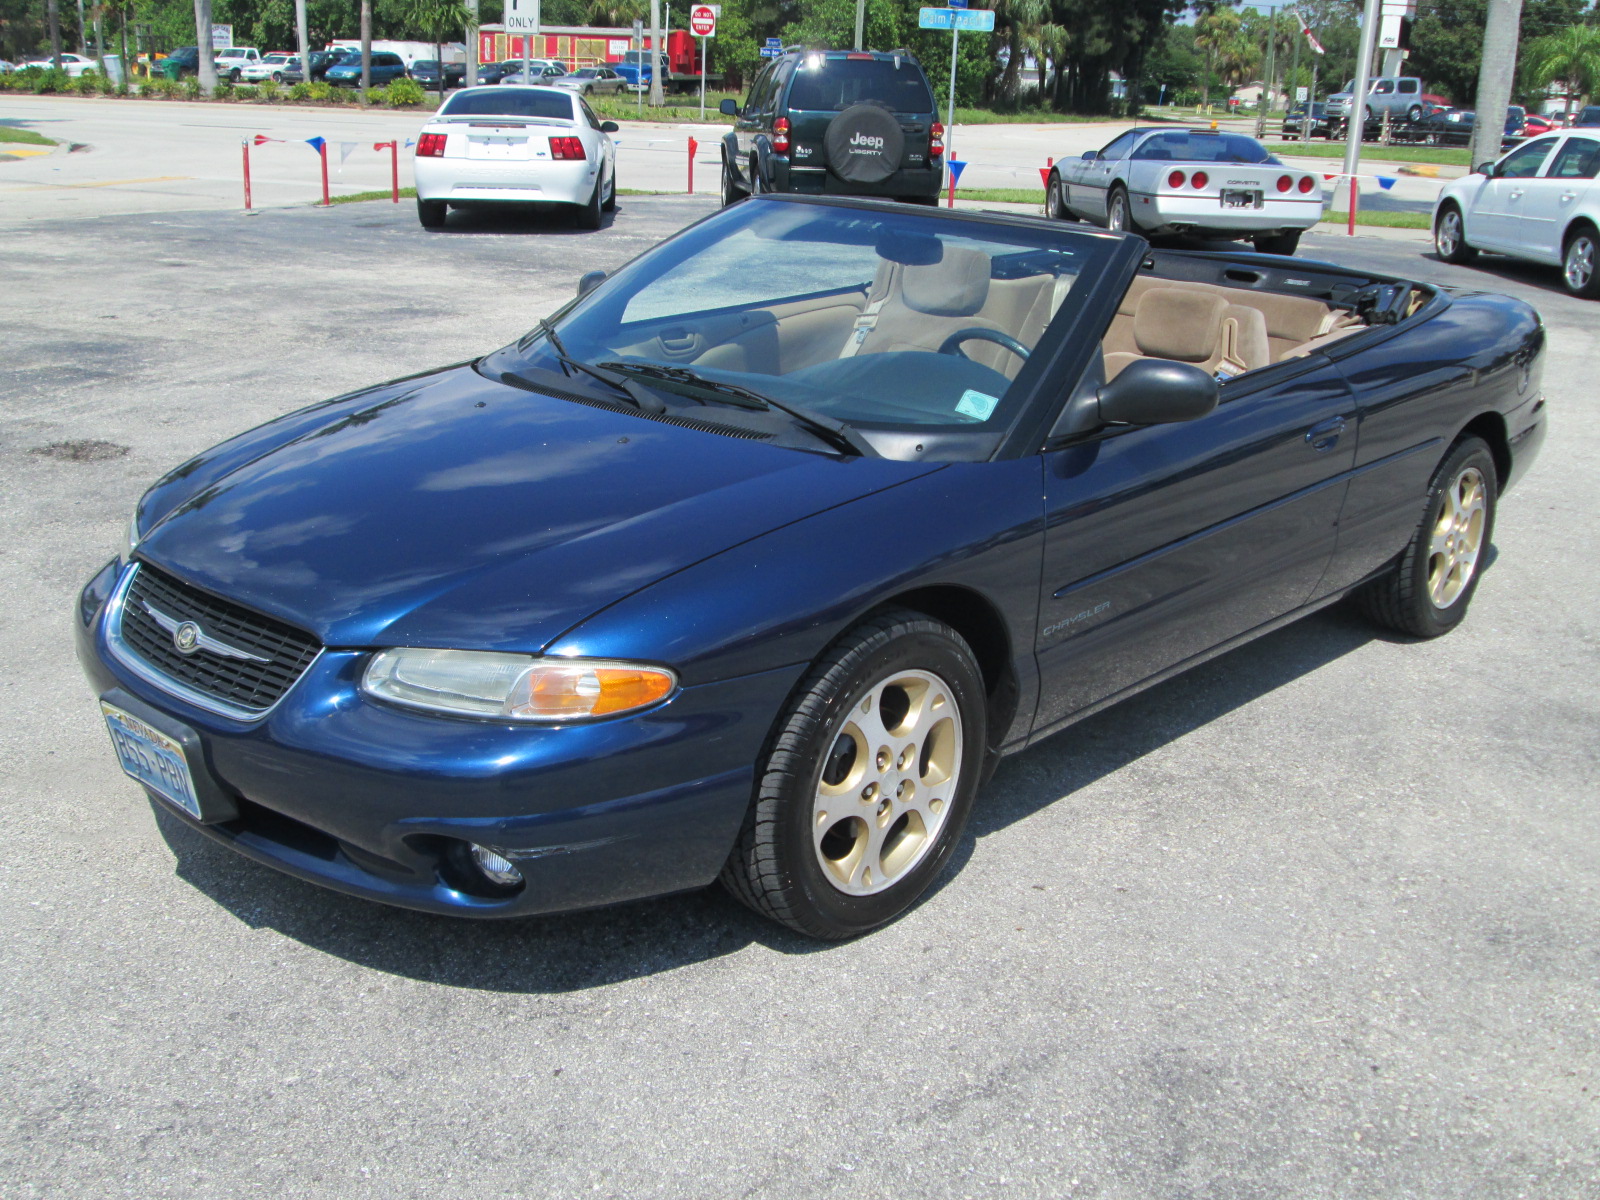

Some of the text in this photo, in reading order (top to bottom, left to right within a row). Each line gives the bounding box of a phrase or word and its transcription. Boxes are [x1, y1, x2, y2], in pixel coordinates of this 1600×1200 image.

[508, 16, 534, 28] ONLY
[922, 12, 946, 25] Palm
[849, 132, 884, 149] Jeep
[848, 148, 883, 156] LIBERTY
[1043, 601, 1111, 636] CHRYSLER
[124, 716, 163, 746] NEVADA
